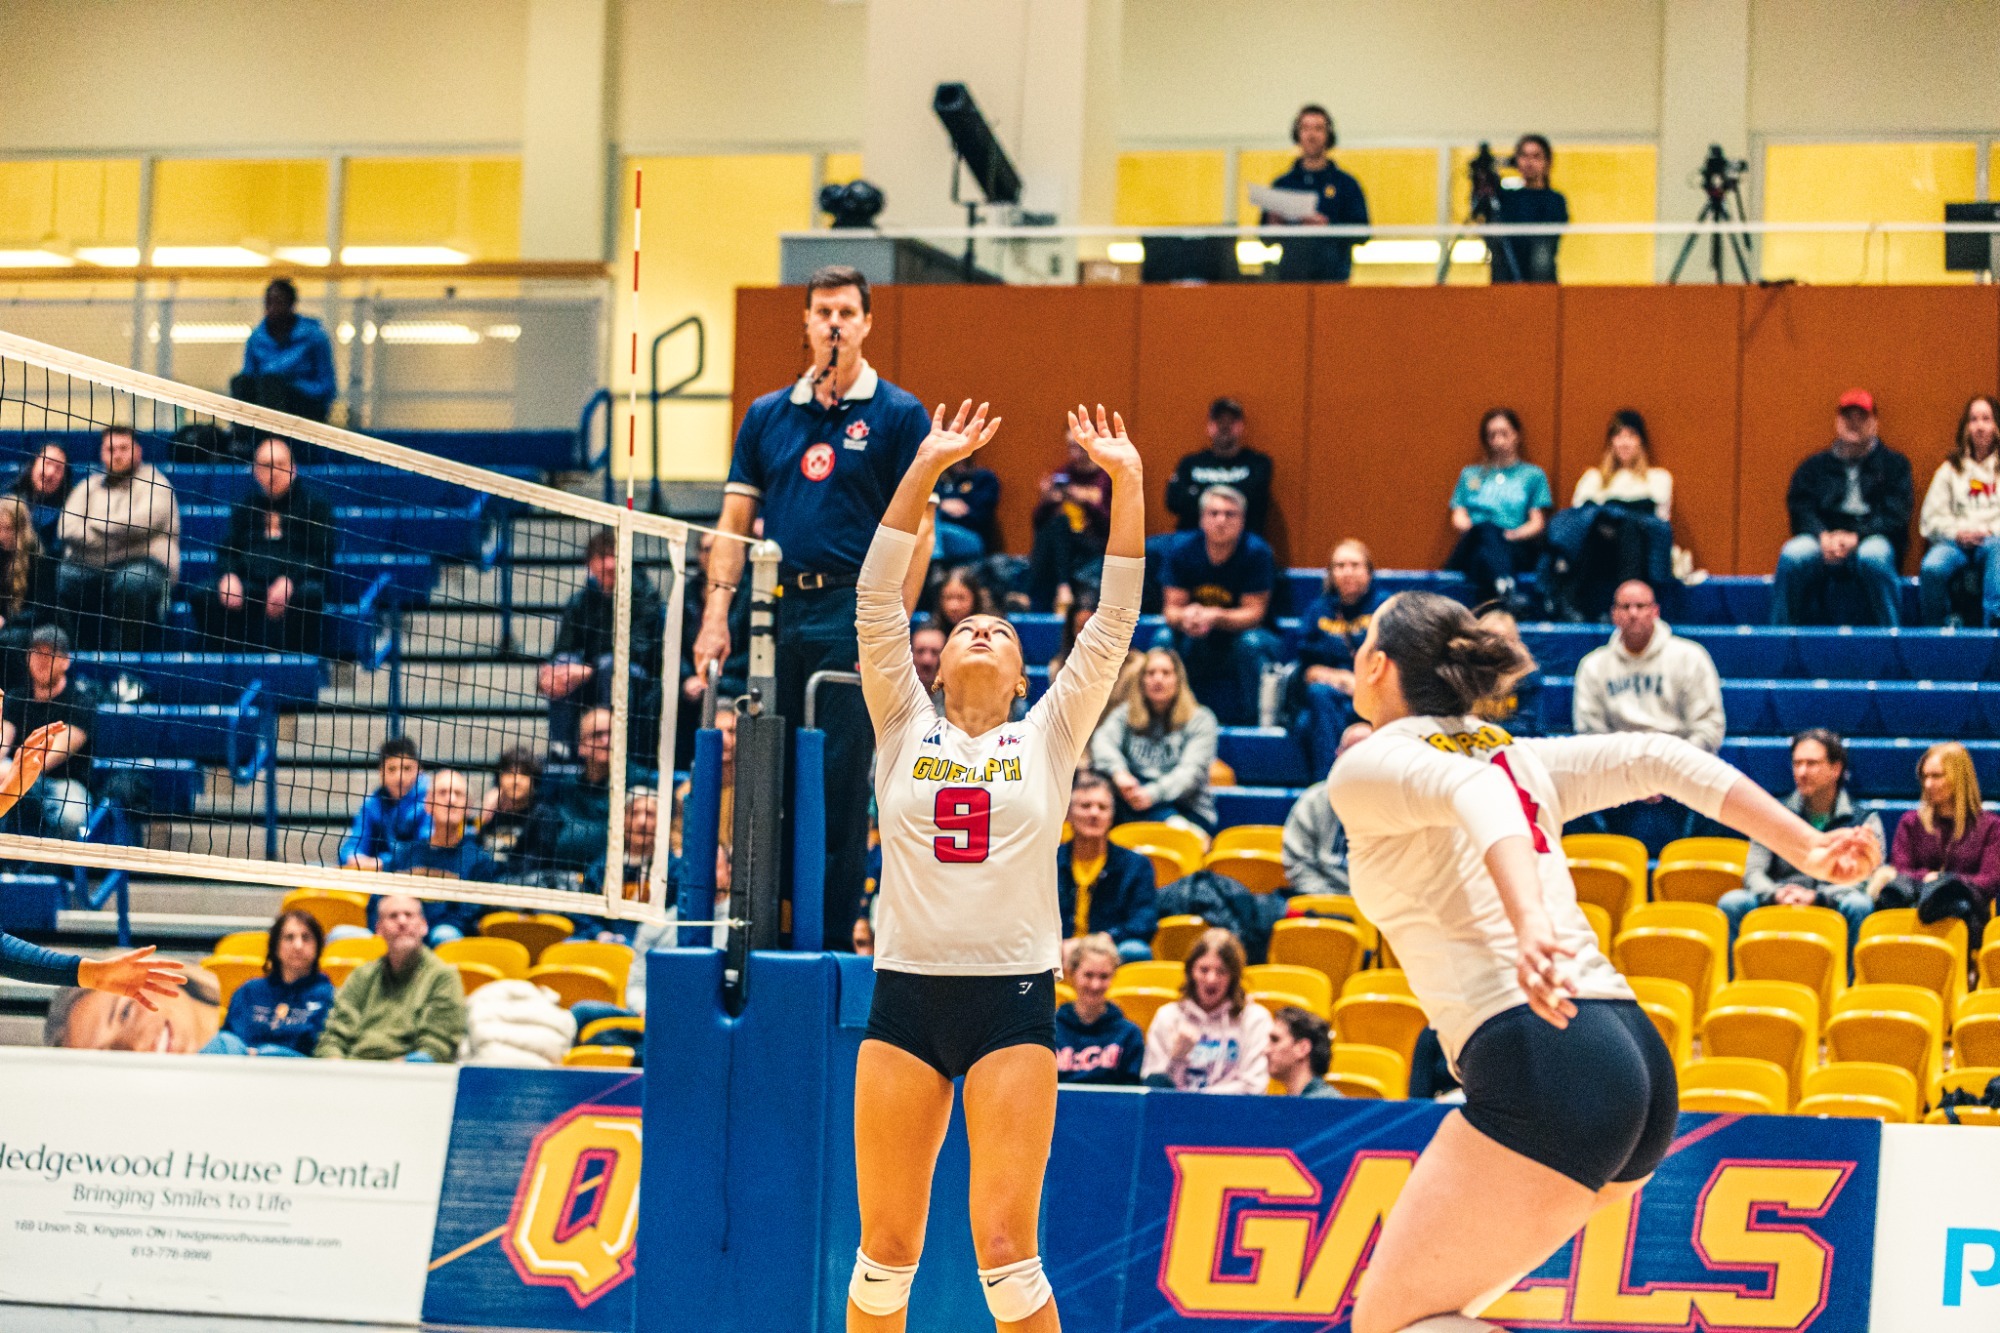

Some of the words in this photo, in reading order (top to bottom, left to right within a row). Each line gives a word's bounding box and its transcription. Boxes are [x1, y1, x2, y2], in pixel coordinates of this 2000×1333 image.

[913, 756, 1022, 783] GUELPH
[934, 787, 991, 863] 9
[184, 1152, 282, 1185] House
[294, 1156, 401, 1190] Dental
[73, 1183, 155, 1210] Bringing
[161, 1188, 221, 1209] Smiles
[228, 1193, 251, 1209] to
[257, 1193, 293, 1213] Life
[501, 1103, 643, 1310] Q
[93, 1225, 142, 1239] Kingston
